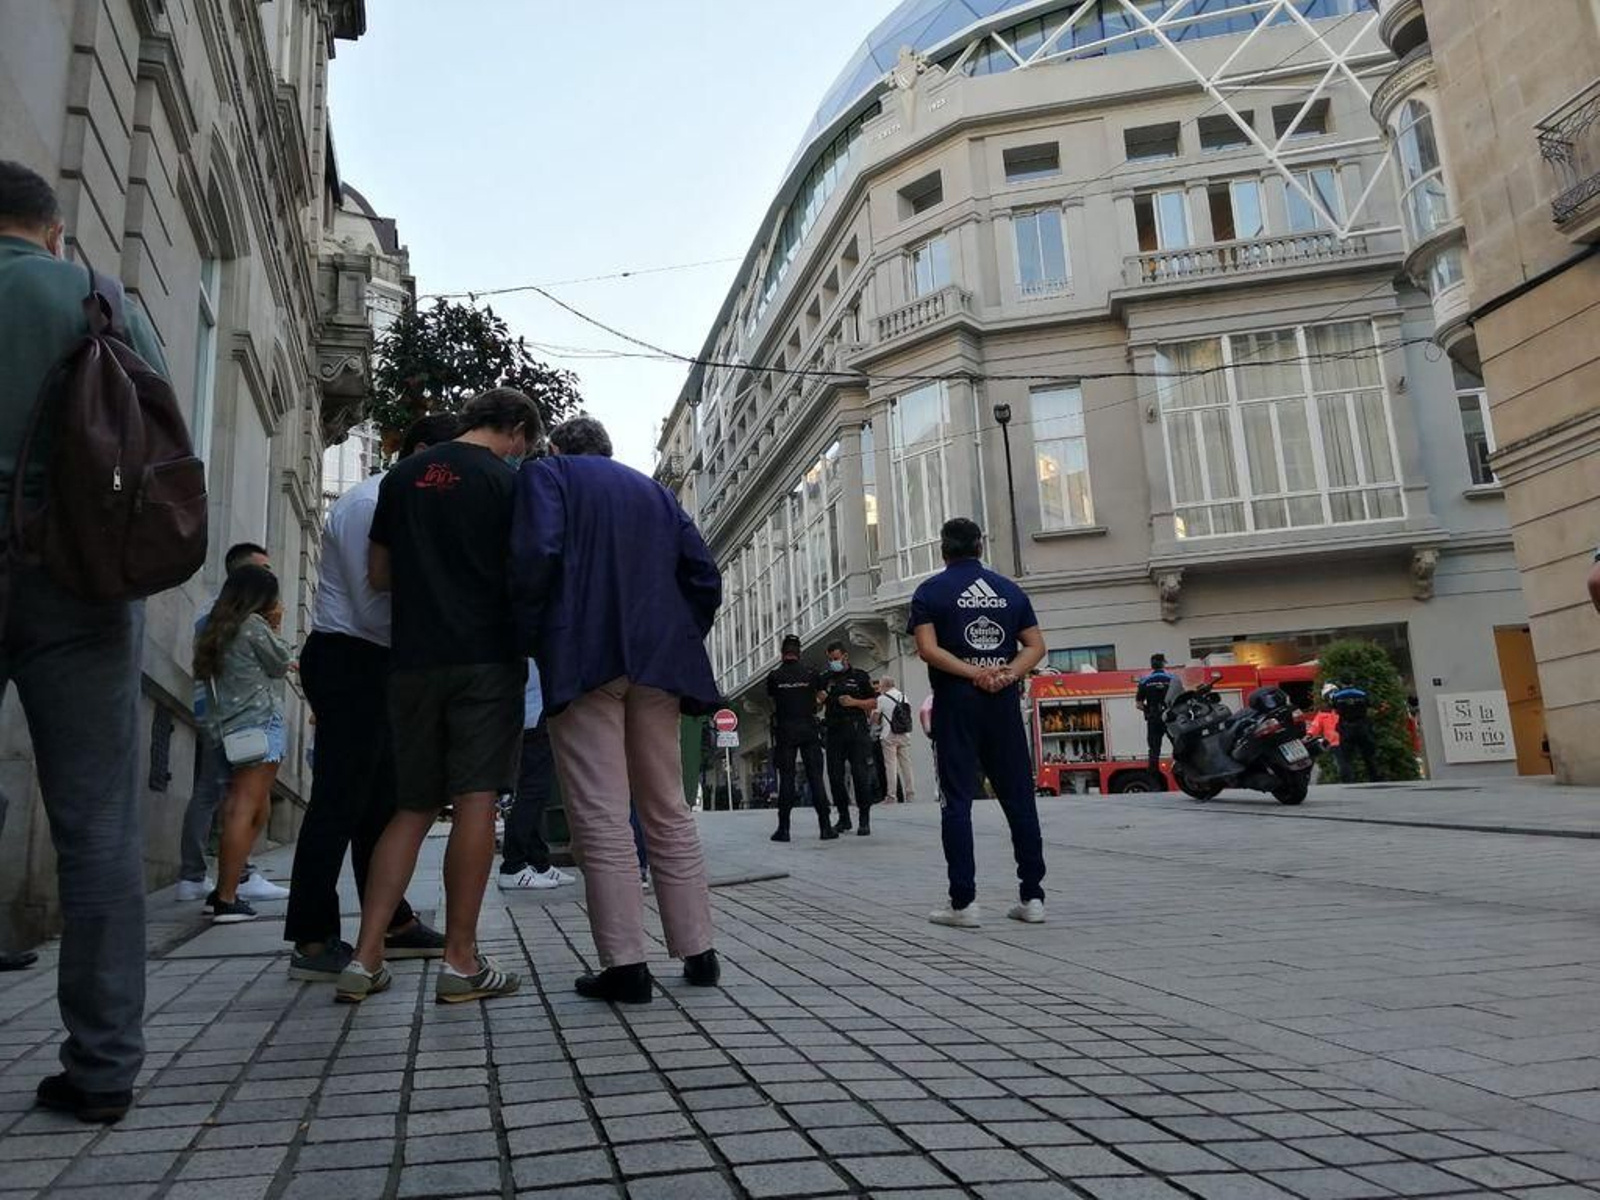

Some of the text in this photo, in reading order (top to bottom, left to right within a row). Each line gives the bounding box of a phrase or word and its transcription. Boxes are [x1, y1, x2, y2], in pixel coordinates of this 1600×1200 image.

[957, 596, 1008, 608] adidas
[963, 657, 1007, 667] BANC
[1479, 705, 1494, 719] la
[1454, 726, 1505, 742] ba rio
